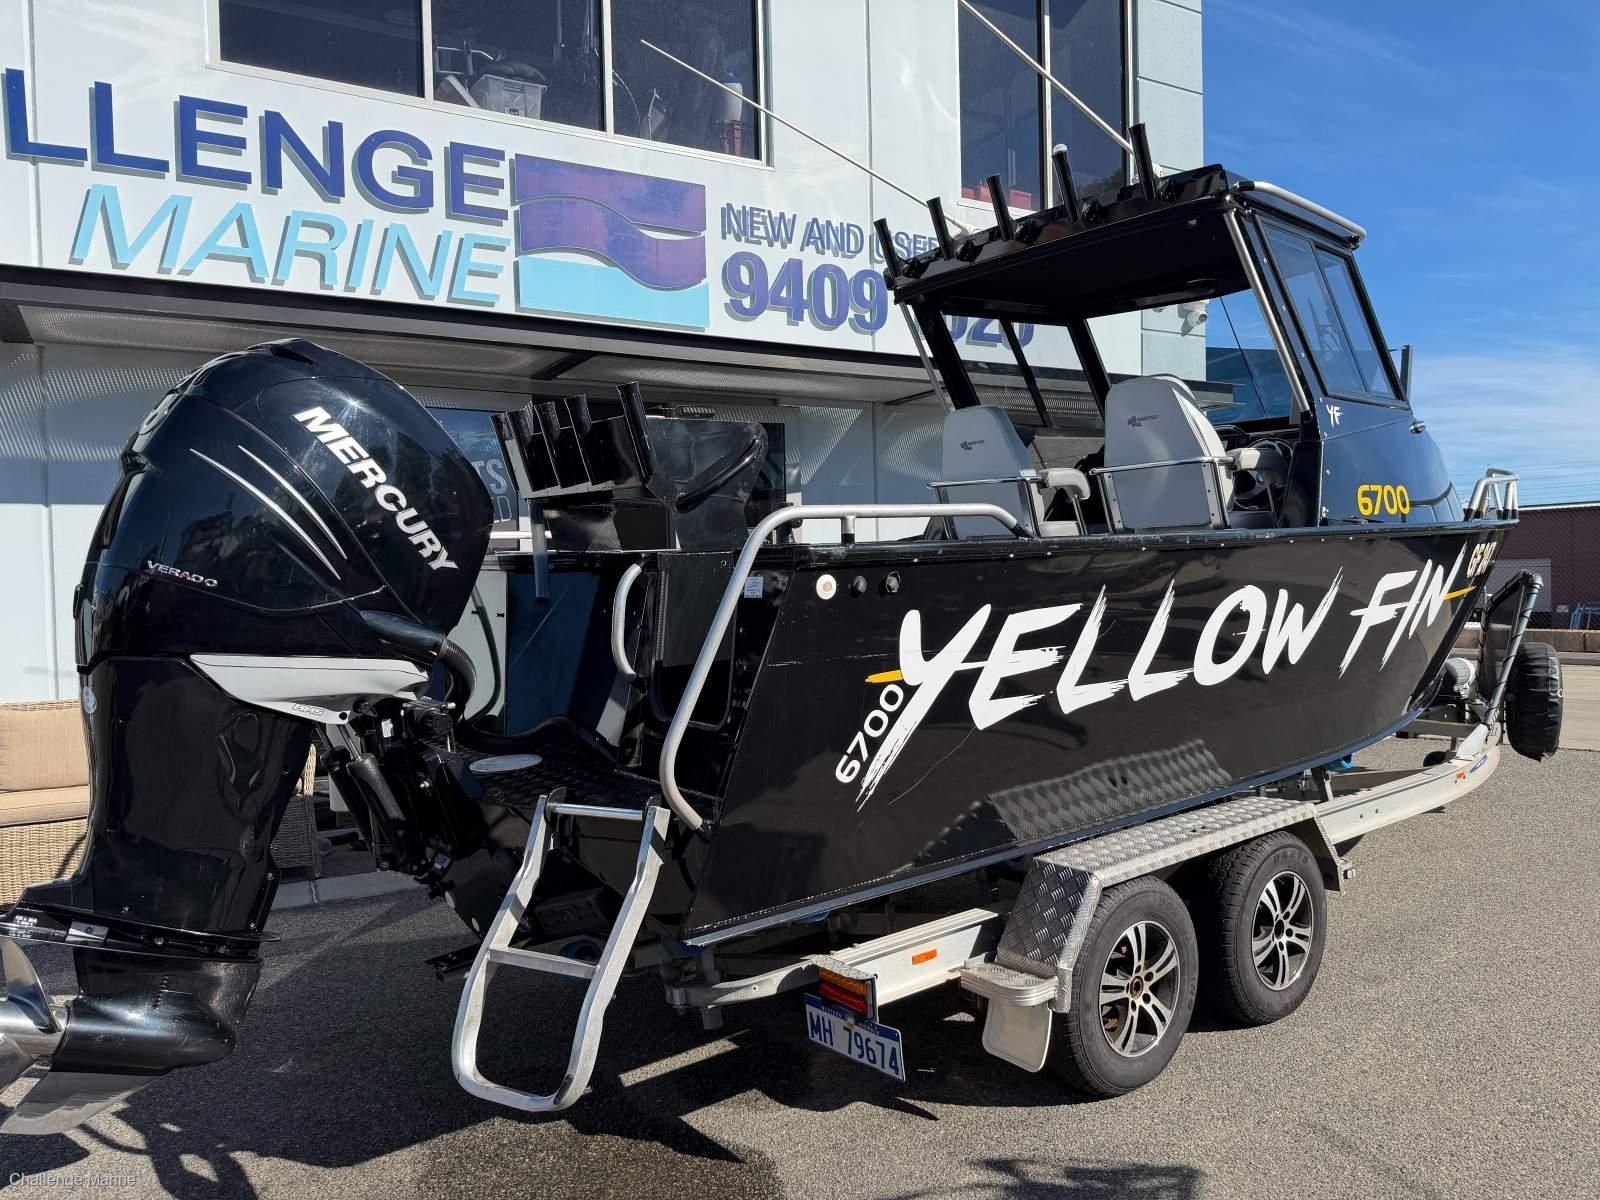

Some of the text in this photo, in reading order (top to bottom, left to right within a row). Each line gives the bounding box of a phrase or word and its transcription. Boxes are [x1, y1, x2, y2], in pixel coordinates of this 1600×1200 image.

[5, 68, 508, 223] LLENGE
[71, 183, 511, 304] MARINE
[722, 203, 797, 245] NEW
[802, 217, 864, 257] AND
[723, 251, 888, 333] 9409
[293, 406, 460, 572] MERCURY
[1357, 484, 1410, 516] 6700
[147, 560, 218, 587] VERADO
[856, 540, 1467, 812] YELLOW FIN
[835, 683, 904, 784] 6700
[809, 1011, 834, 1047] MH
[843, 1026, 899, 1075] 79674
